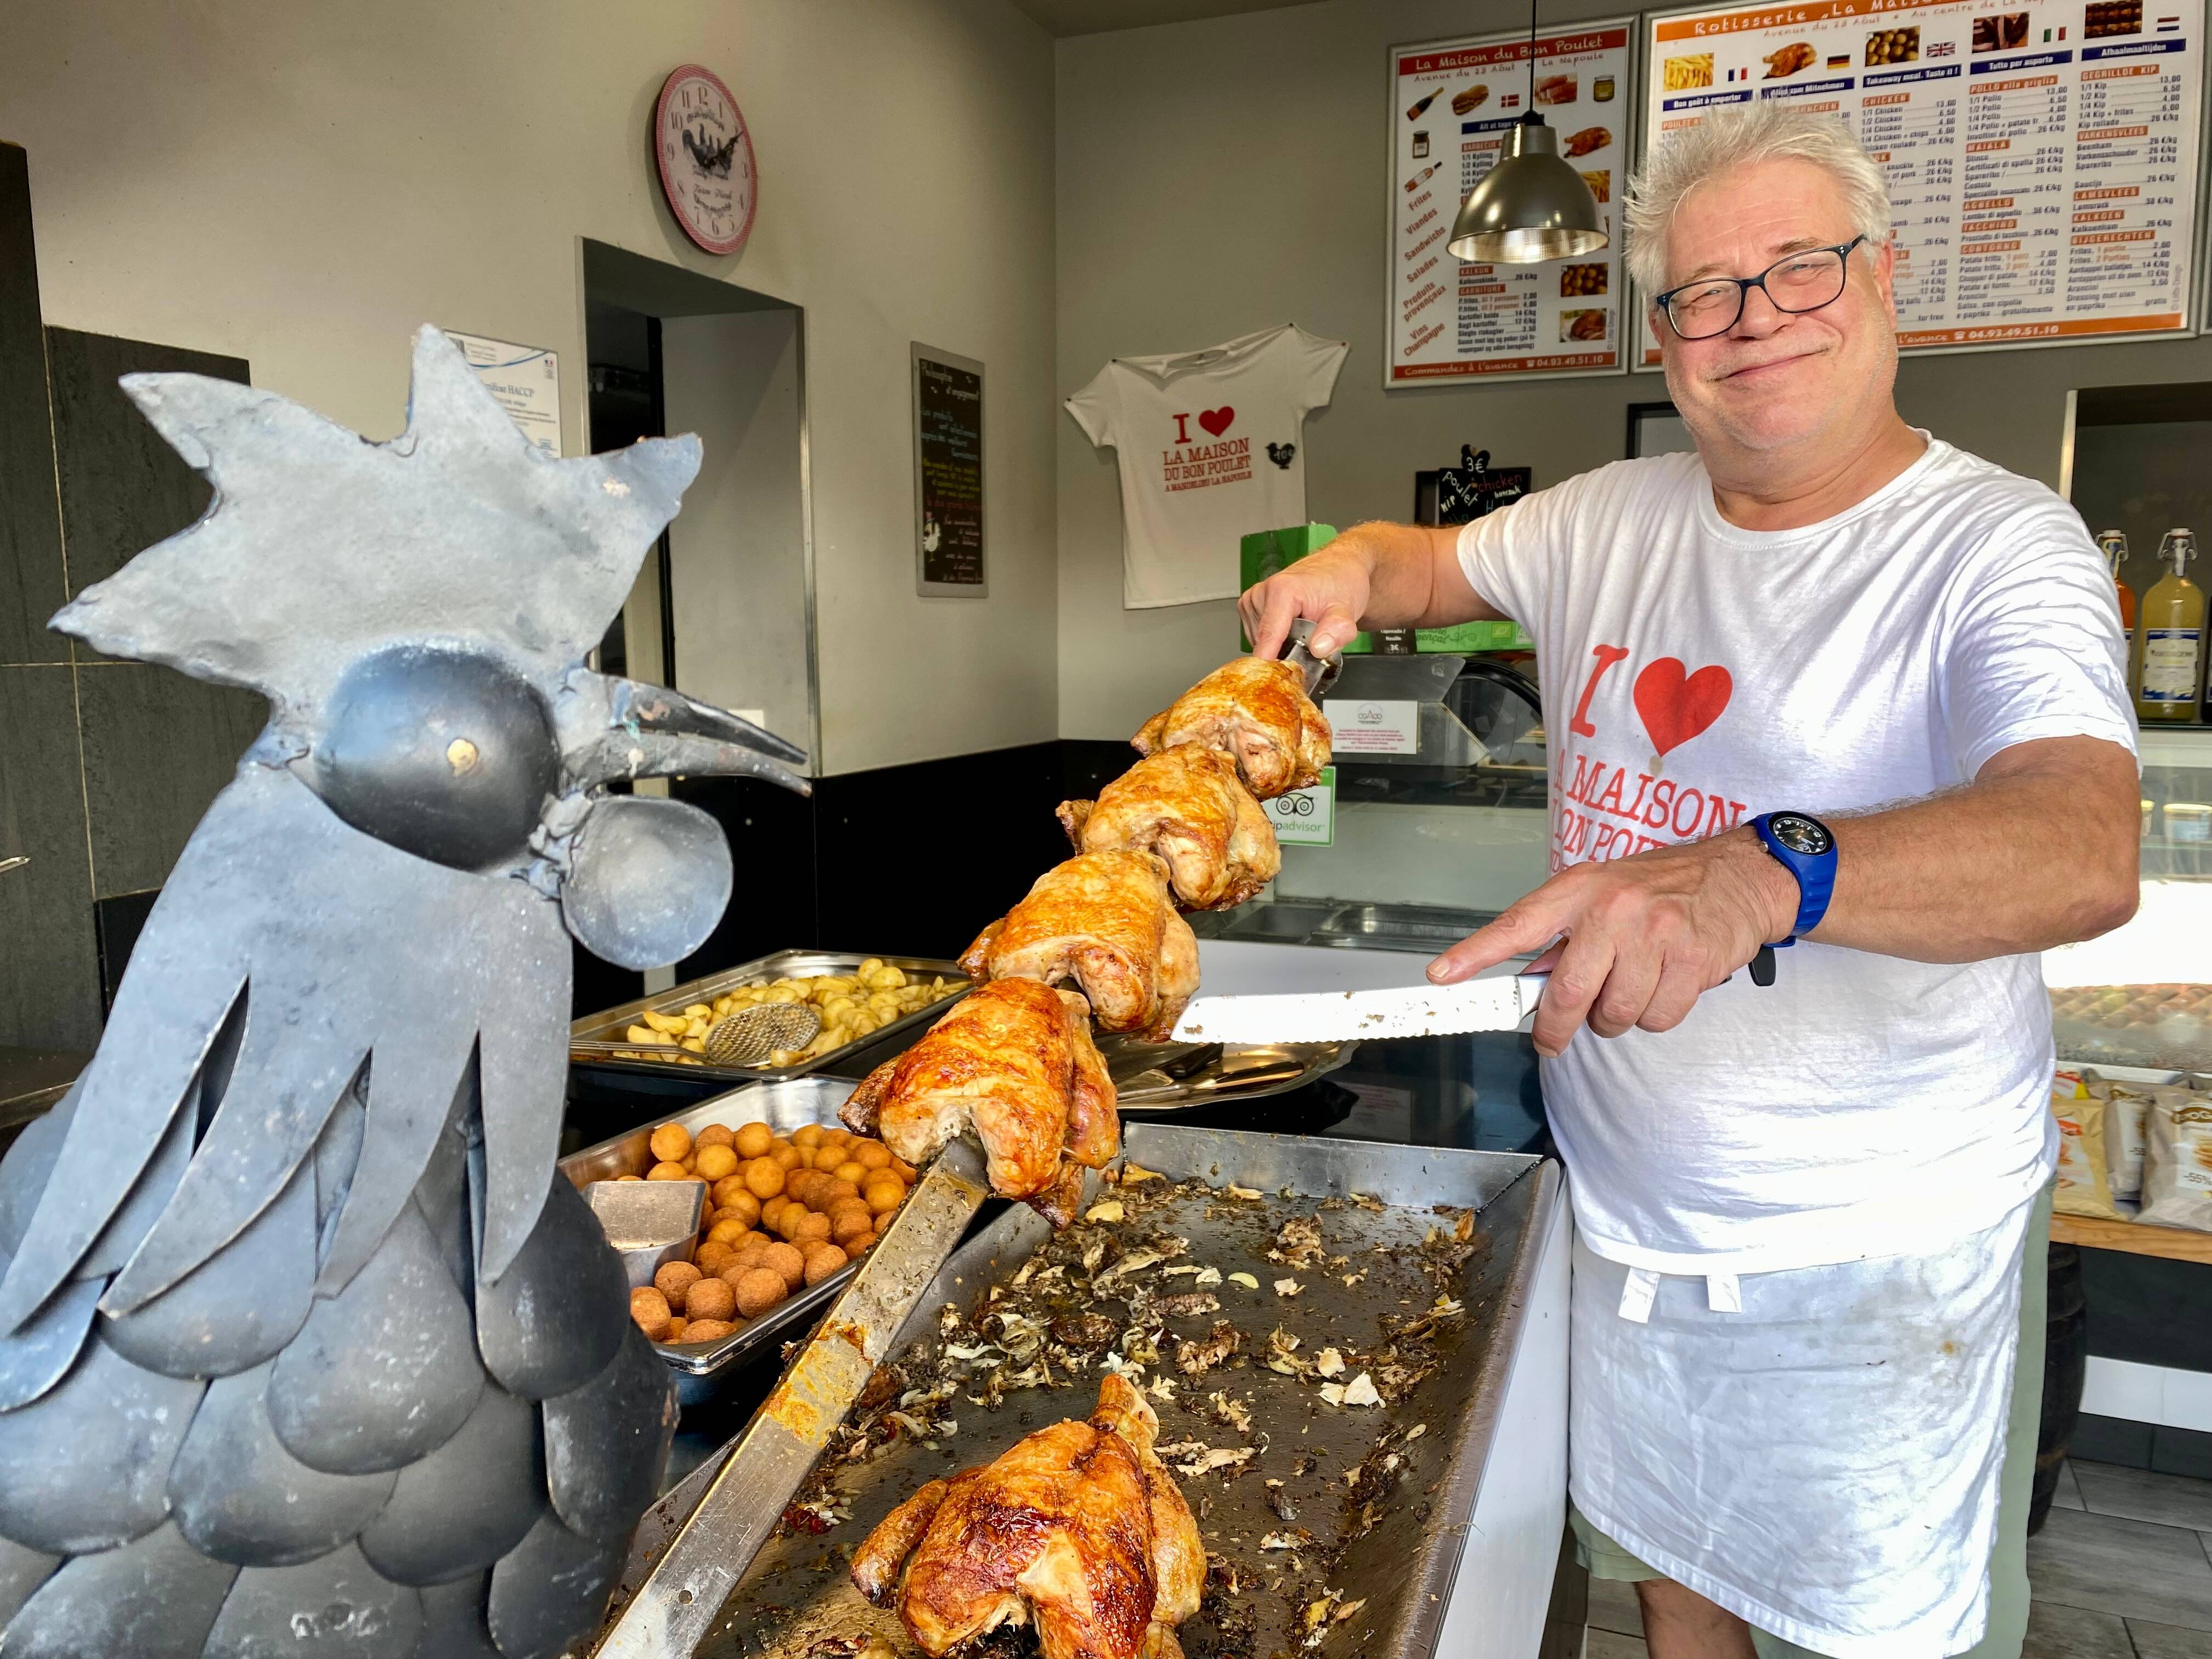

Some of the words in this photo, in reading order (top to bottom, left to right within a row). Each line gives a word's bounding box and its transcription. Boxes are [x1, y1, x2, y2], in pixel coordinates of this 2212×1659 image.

[1812, 22, 1827, 31] du
[1416, 59, 1432, 70] La
[1438, 54, 1488, 67] Maison
[1494, 47, 1513, 59] du
[1556, 35, 1603, 53] Poulet
[1414, 73, 1451, 82] Avenue
[2141, 65, 2156, 74] KIP
[682, 89, 690, 108] 11
[719, 100, 722, 118] 1
[1864, 94, 1906, 105] CHICKEN
[671, 112, 682, 131] 10
[1409, 190, 1432, 211] Frites
[1406, 208, 1437, 234] Viandes
[1405, 227, 1446, 261] Sandwichs
[1407, 256, 1438, 283] Salades
[1403, 281, 1435, 309] Produits
[1404, 323, 1445, 356] Champagne
[1410, 324, 1429, 339] Vins
[1172, 413, 1192, 444] I
[1163, 450, 1184, 465] LA
[1187, 437, 1250, 462] MAISON
[1164, 467, 1180, 481] DU
[1183, 463, 1205, 478] BON
[1208, 455, 1251, 475] POULET
[1478, 473, 1522, 492] chicken
[1570, 644, 1629, 737] I
[1566, 754, 1747, 837] MAISON
[1273, 820, 1322, 832] ipadvisor
